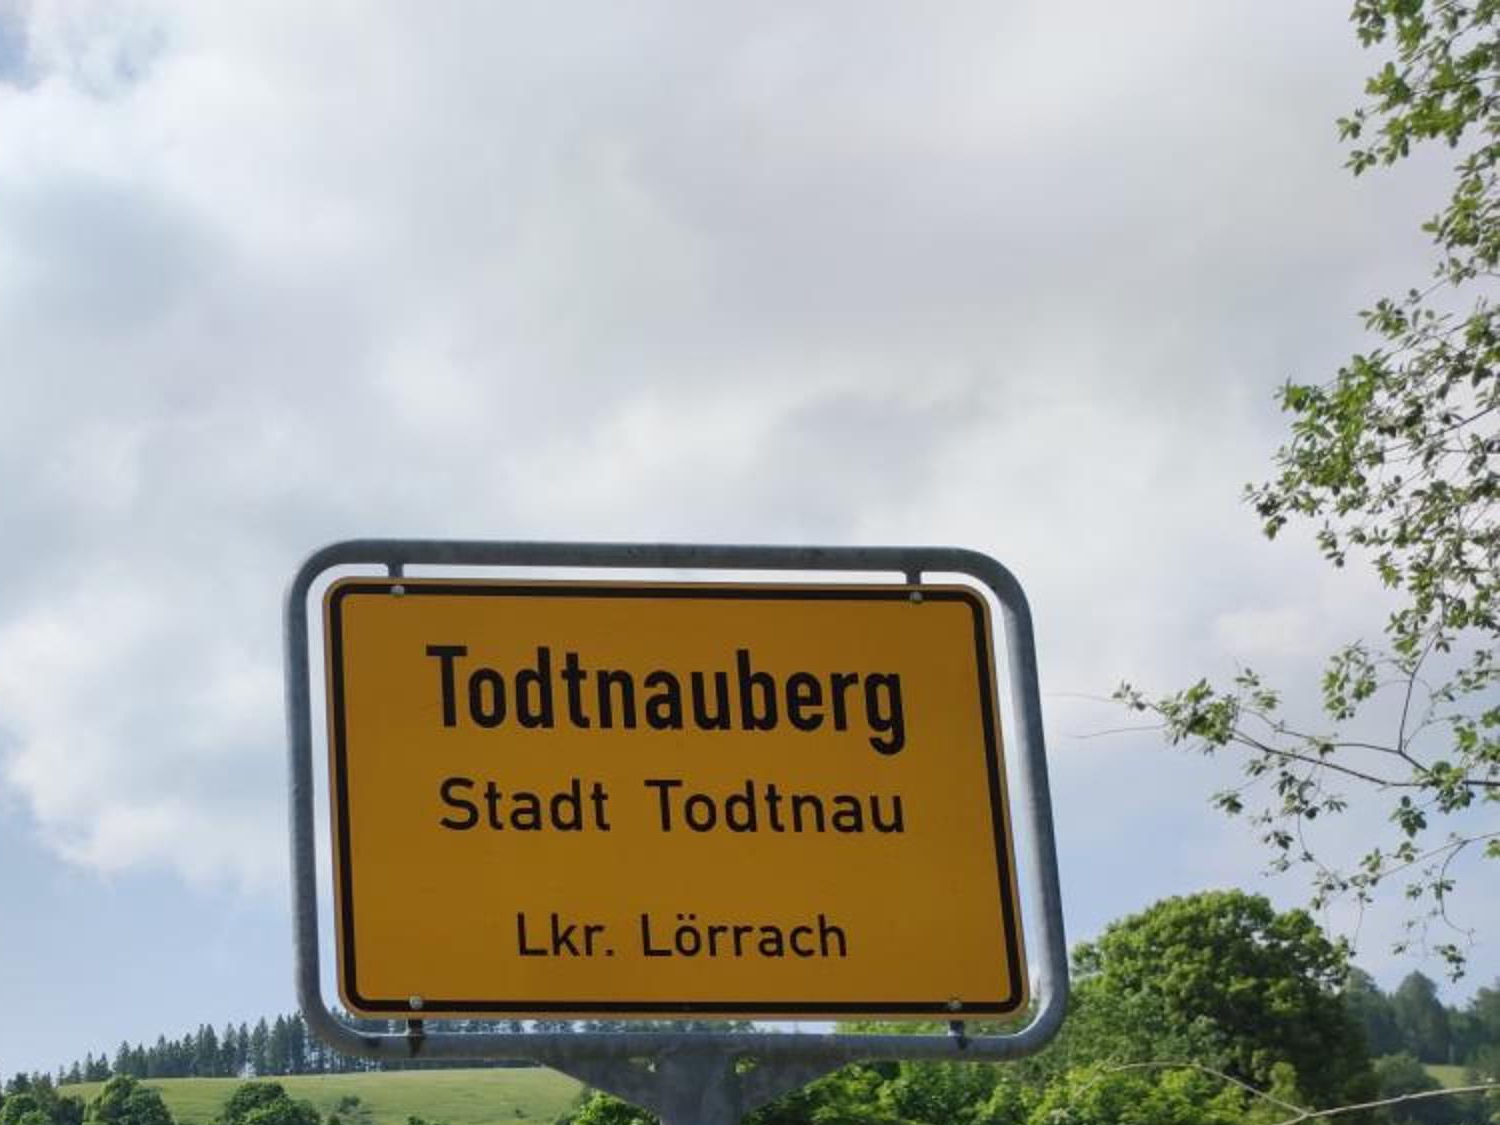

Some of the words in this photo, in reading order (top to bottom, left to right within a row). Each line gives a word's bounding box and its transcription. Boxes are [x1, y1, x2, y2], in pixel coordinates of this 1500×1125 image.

[426, 645, 906, 756] Todtnauberg
[439, 777, 611, 832] Stadt
[643, 779, 905, 834] Todtnau
[517, 911, 615, 957] Lkr.
[640, 912, 847, 958] Lörrach
